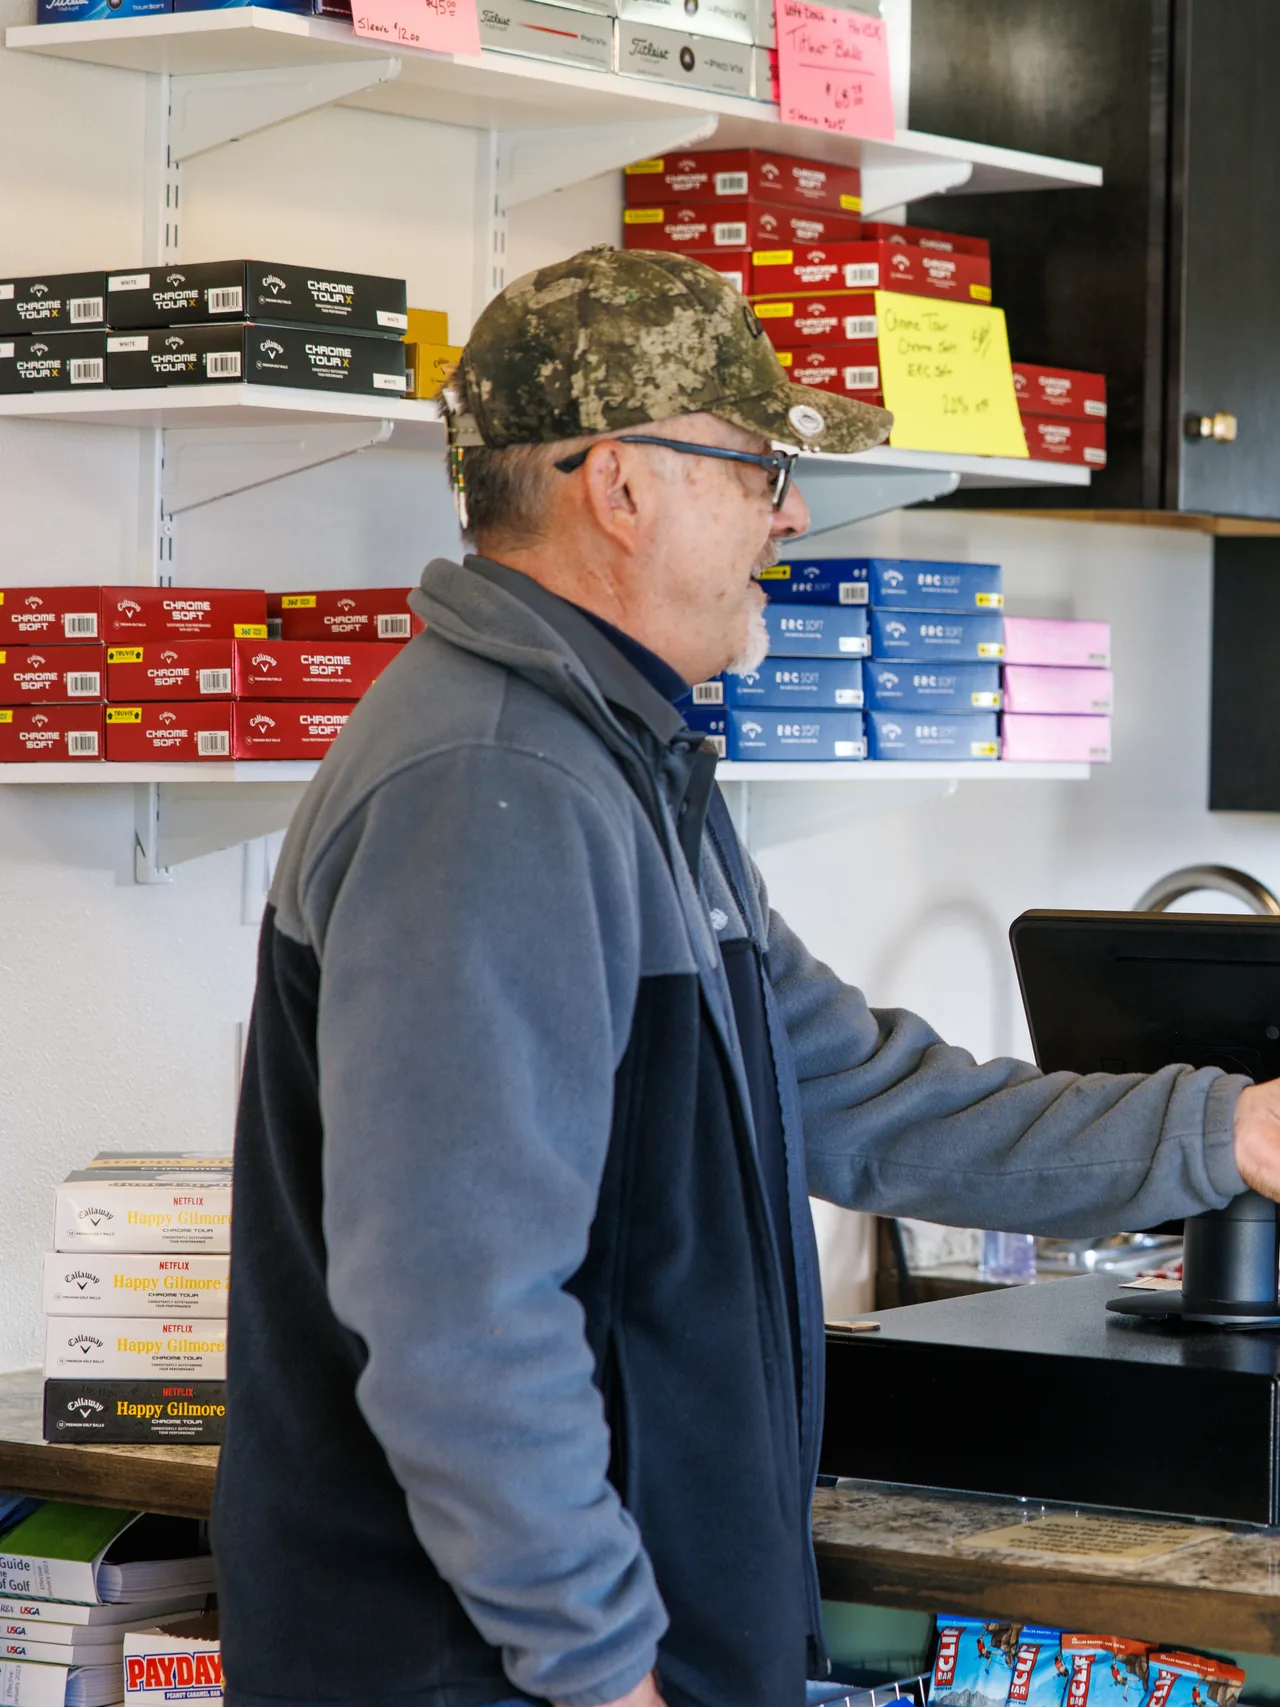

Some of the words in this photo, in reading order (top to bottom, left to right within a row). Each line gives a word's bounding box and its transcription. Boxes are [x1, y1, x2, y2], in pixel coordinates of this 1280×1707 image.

[307, 280, 354, 295] CHROME
[153, 290, 199, 301] CHROME
[311, 291, 344, 303] TOUR
[345, 295, 353, 304] X
[17, 300, 61, 311] CHROME
[155, 300, 188, 310] TOUR
[189, 299, 197, 307] X
[19, 310, 50, 319] TOUR
[51, 309, 59, 317] X
[305, 344, 352, 358] CHROME
[151, 353, 197, 364] CHROME
[308, 355, 341, 367] TOUR
[342, 358, 350, 368] X
[17, 360, 61, 370] CHROME
[153, 362, 186, 372] TOUR
[187, 363, 195, 371] X
[19, 369, 50, 378] TOUR
[51, 369, 59, 377] X
[163, 600, 211, 611] CHROME
[11, 613, 56, 622] CHROME
[172, 611, 204, 620] SOFT
[324, 615, 368, 624] CHROME
[18, 622, 49, 631] SOFT
[331, 624, 361, 633] SOFT
[252, 653, 277, 667] Callaway
[301, 655, 351, 665] CHROME
[147, 668, 190, 677] CHROME
[309, 665, 344, 675] SOFT
[13, 672, 58, 681] CHROME
[154, 677, 183, 686] SOFT
[21, 681, 51, 690] SOFT
[249, 714, 276, 728] Callaway
[146, 729, 189, 738] CHROME
[308, 725, 342, 735] SOFT
[19, 731, 60, 741] CHROME
[26, 740, 54, 749] SOFT
[153, 738, 181, 747] SOFT
[173, 1197, 204, 1206] NETFLIX
[78, 1206, 114, 1220] Callaway
[127, 1210, 173, 1227] Happy
[159, 1261, 189, 1270] NETFLIX
[65, 1270, 100, 1284] Callaway
[113, 1274, 159, 1291] Happy
[163, 1275, 221, 1290] Gilmore
[162, 1325, 193, 1333] NETFLIX
[67, 1334, 104, 1348] Callaway
[117, 1338, 163, 1354] Happy
[167, 1338, 225, 1353] Gilmore
[163, 1387, 193, 1397] NETFLIX
[67, 1397, 104, 1412] Callaway
[117, 1401, 163, 1418] Happy
[167, 1402, 225, 1417] Gilmore
[0, 1557, 30, 1571] Guide
[9, 1580, 30, 1592] Golf
[20, 1606, 41, 1616] USGA
[7, 1625, 26, 1635] USGA
[7, 1645, 26, 1656] USGA
[938, 1628, 959, 1671] CLIF
[1013, 1645, 1036, 1686] CLIF
[126, 1653, 222, 1692] PAYDAY
[937, 1671, 952, 1680] BAR
[1071, 1656, 1090, 1696] CLIF
[6, 1670, 14, 1698] Effective
[166, 1691, 186, 1699] PEANUT
[186, 1690, 209, 1698] CARAMEL
[1070, 1697, 1084, 1705] BAR
